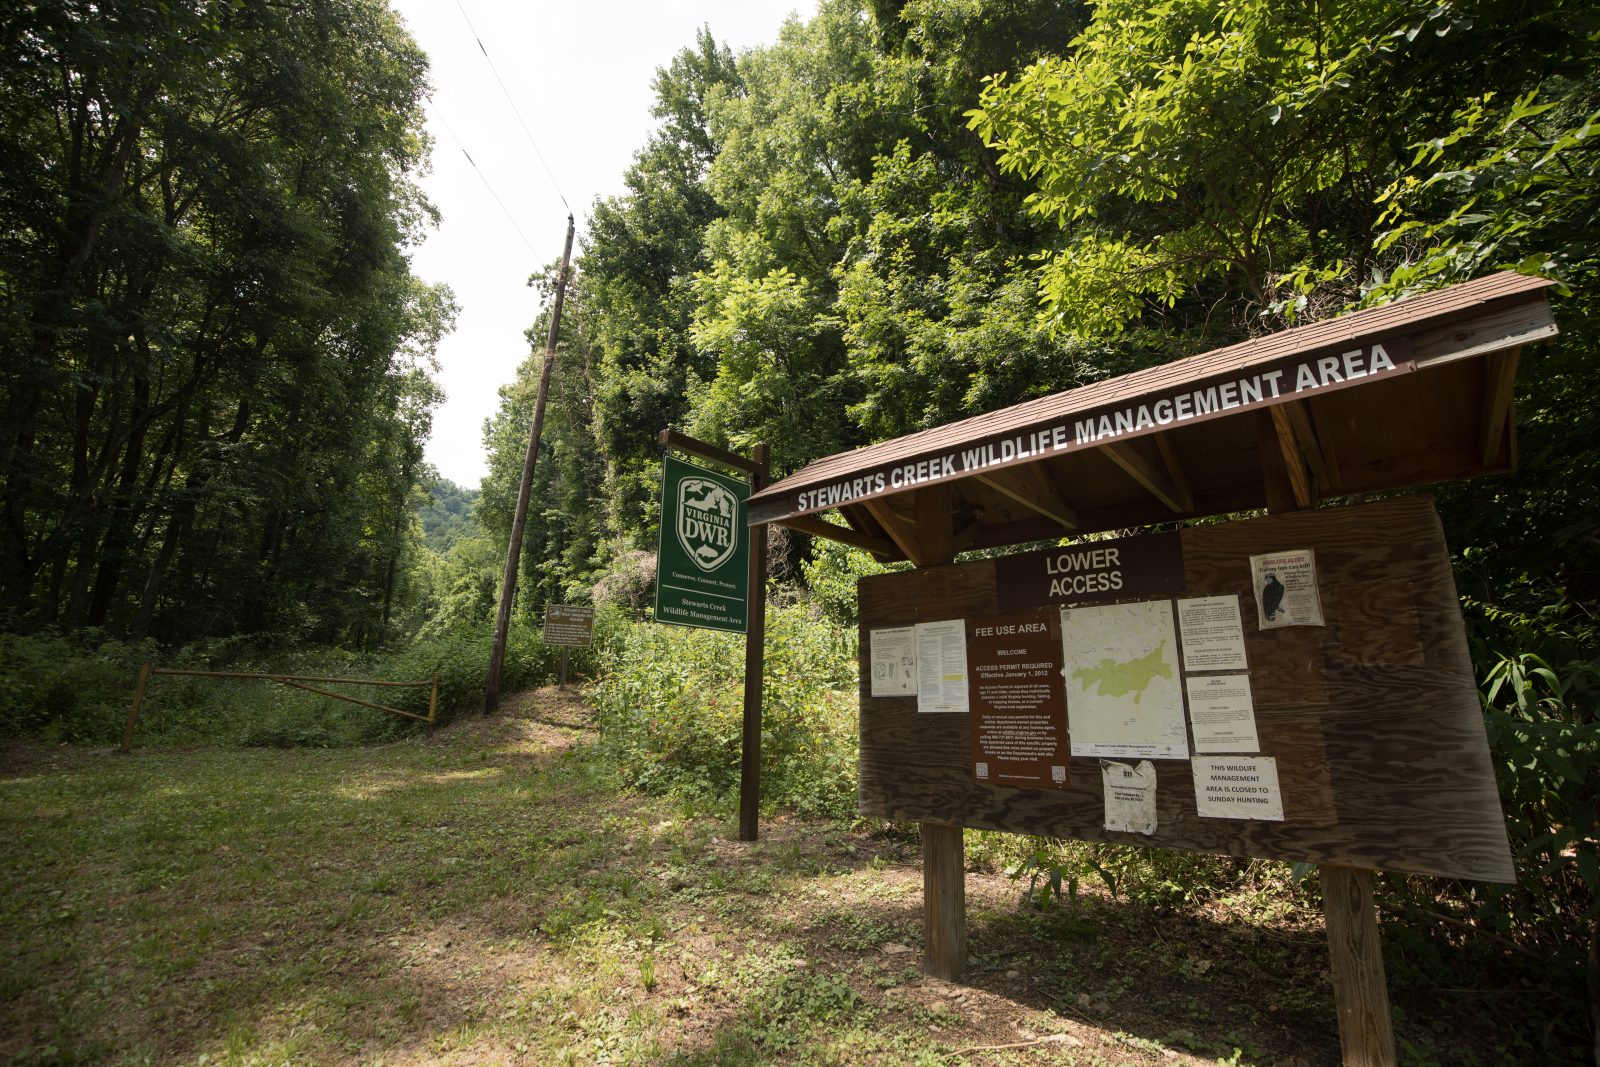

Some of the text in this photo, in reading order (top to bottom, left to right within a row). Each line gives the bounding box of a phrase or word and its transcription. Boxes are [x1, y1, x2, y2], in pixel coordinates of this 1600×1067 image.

[798, 344, 1396, 512] STEWARTS CREEK WILDLIFE MANAGEMENT AREA
[686, 507, 730, 528] VIRGINIA
[685, 518, 729, 548] DWR
[1047, 548, 1120, 574] LOWER
[672, 572, 736, 589] Conserve. Connect. Protect.
[1049, 571, 1123, 597] ACCESS
[663, 607, 688, 616] Wildlife
[690, 611, 728, 621] Management
[682, 599, 708, 609] Stewarts
[976, 623, 1047, 637] FEE USE AREA
